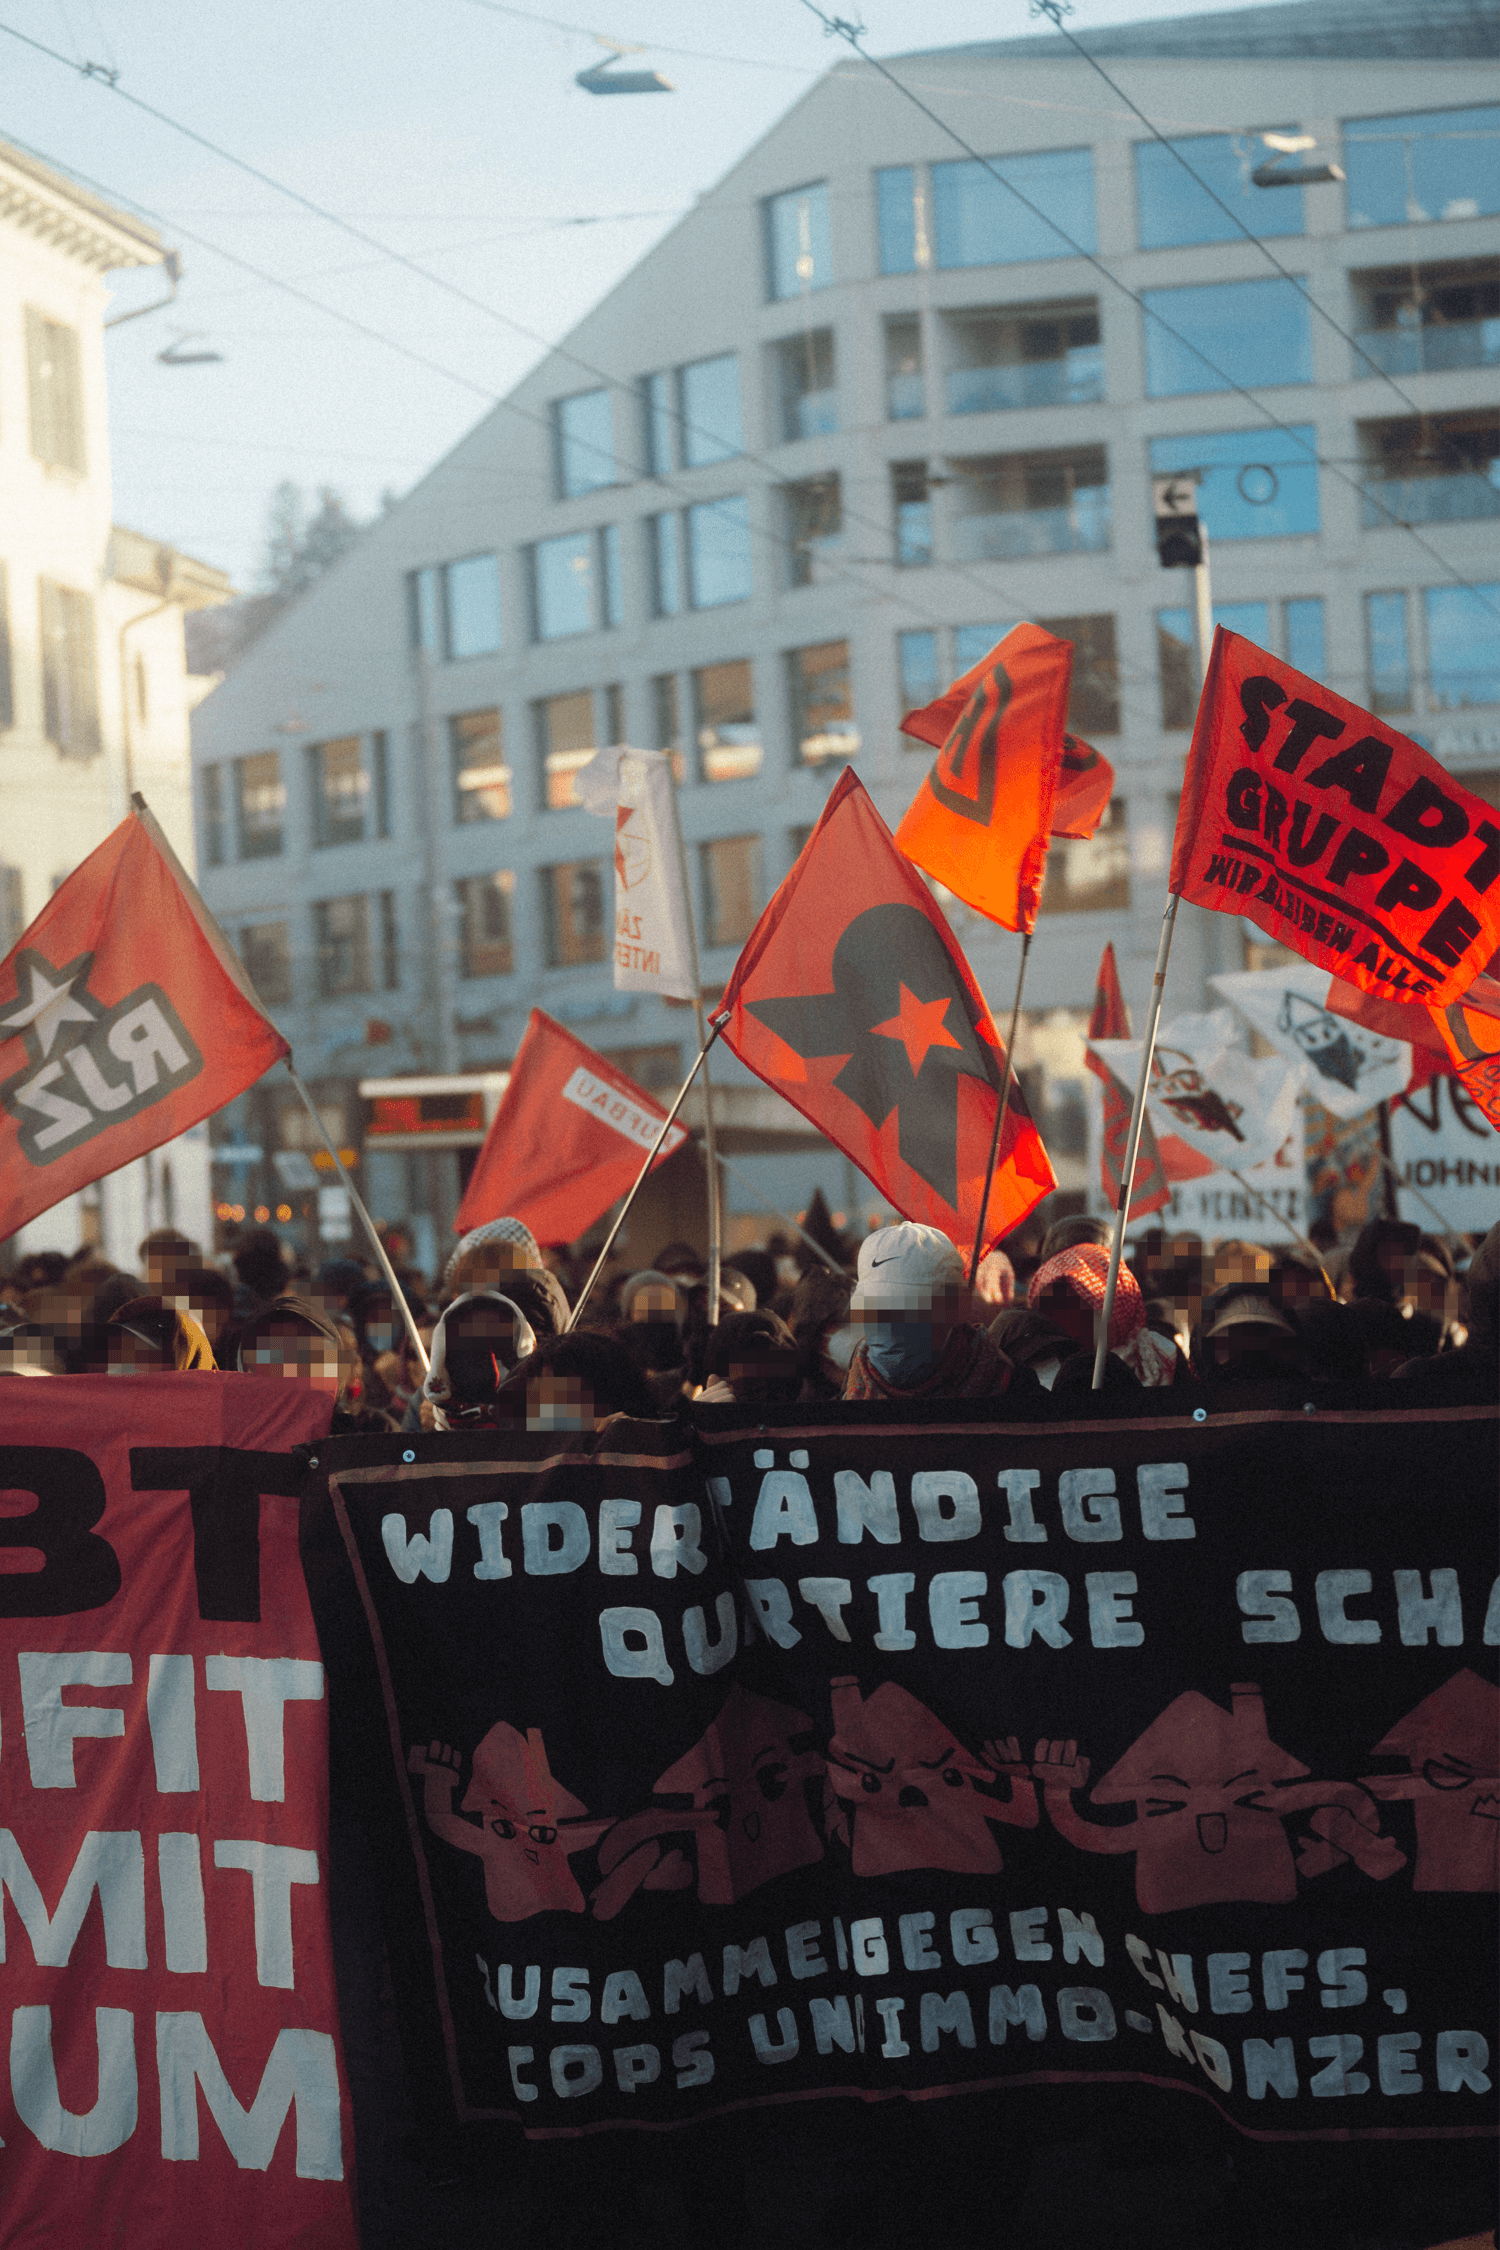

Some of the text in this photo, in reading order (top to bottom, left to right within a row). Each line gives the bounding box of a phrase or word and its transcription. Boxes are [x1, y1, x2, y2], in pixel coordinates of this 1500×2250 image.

[1203, 853, 1434, 996] WIR BLEIBEN ALLE
[1225, 767, 1482, 969] GRUPPE
[1398, 1158, 1500, 1187] JOHN
[599, 1567, 1500, 1686] QURTIERE SCH
[473, 1915, 848, 2024] USAMME
[851, 1906, 1105, 1977] GEGEN
[747, 1994, 866, 2065] UN
[0, 2004, 345, 2182] UM
